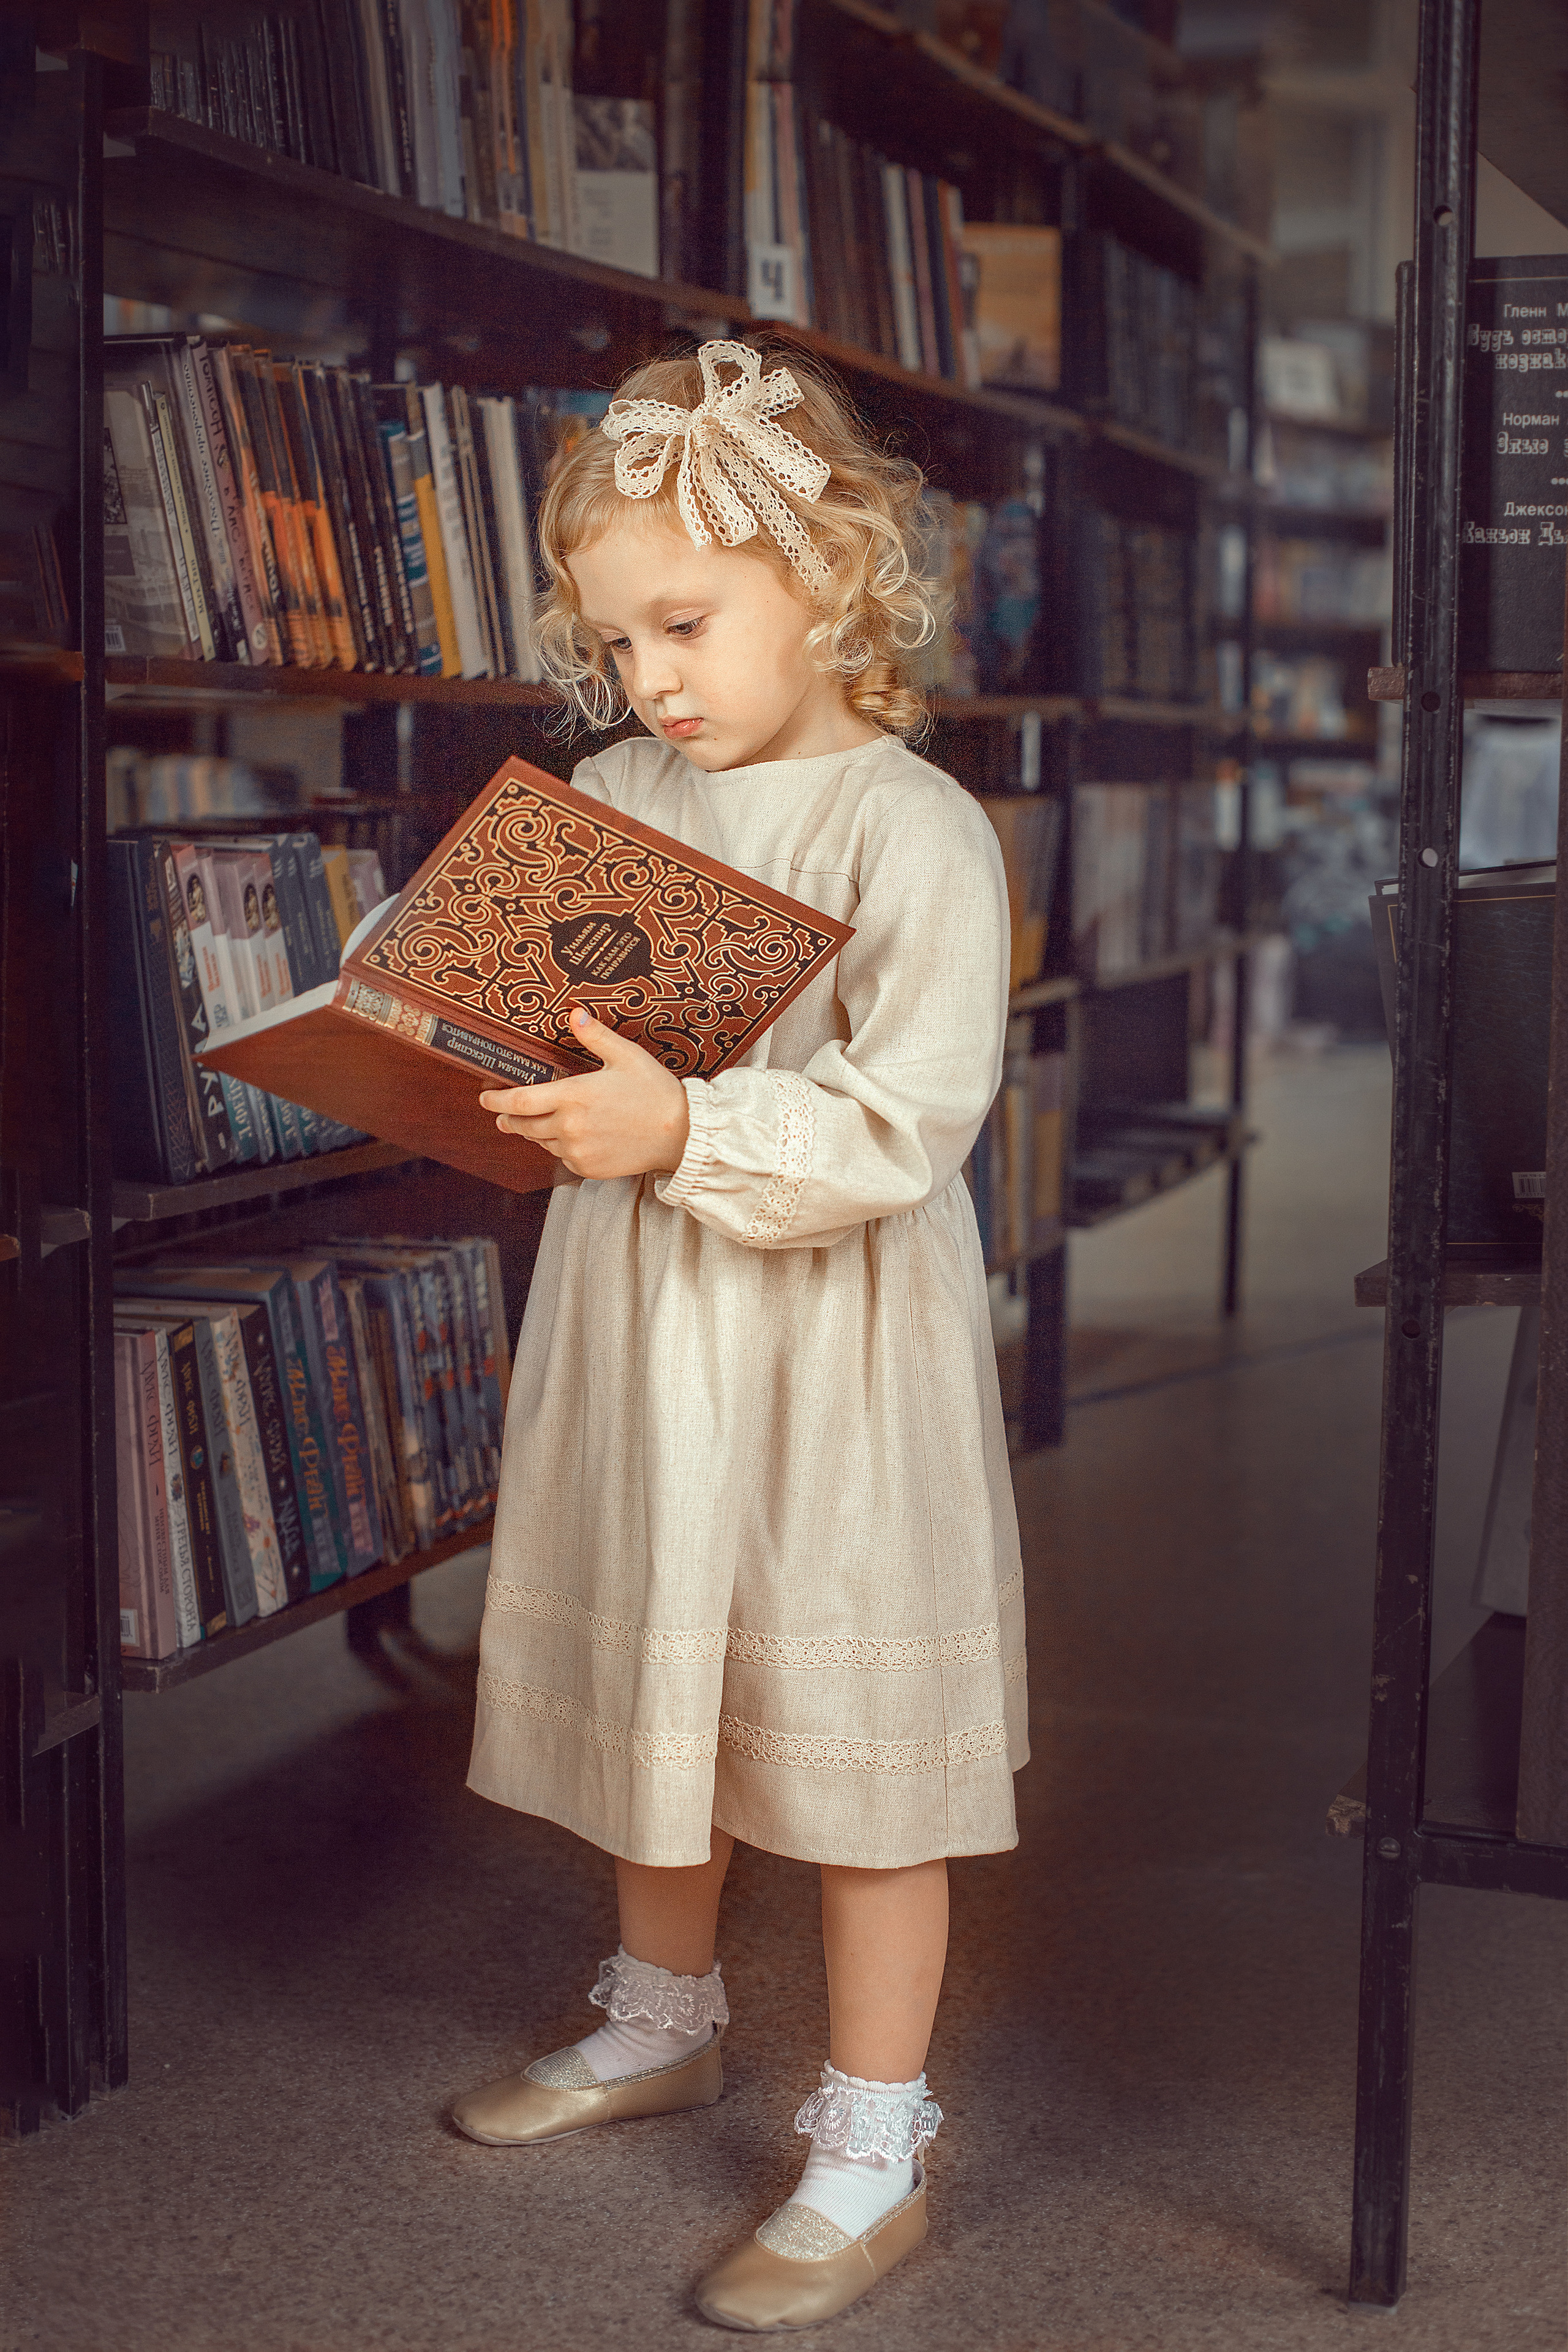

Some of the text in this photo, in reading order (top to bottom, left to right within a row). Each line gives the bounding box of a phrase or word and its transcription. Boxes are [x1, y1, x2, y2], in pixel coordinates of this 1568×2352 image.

[1504, 304, 1547, 317] Гленн
[1522, 328, 1568, 345] осто
[1495, 348, 1568, 372] незнак
[184, 364, 206, 454] пророчество
[1502, 413, 1559, 429] Норман
[560, 921, 597, 956] Уильям
[569, 922, 612, 966] Шекспир
[591, 931, 632, 976] КАК ВАМ ЭТО
[600, 936, 641, 980] ПОНРАВИТСЯ
[442, 1022, 548, 1075] КАК ВАМ ЭТО ПОНРАВИТСЯ
[447, 1036, 537, 1085] Уильям Шекспир
[175, 1519, 197, 1632] ТРЕТЬЯ СТОРОНА
